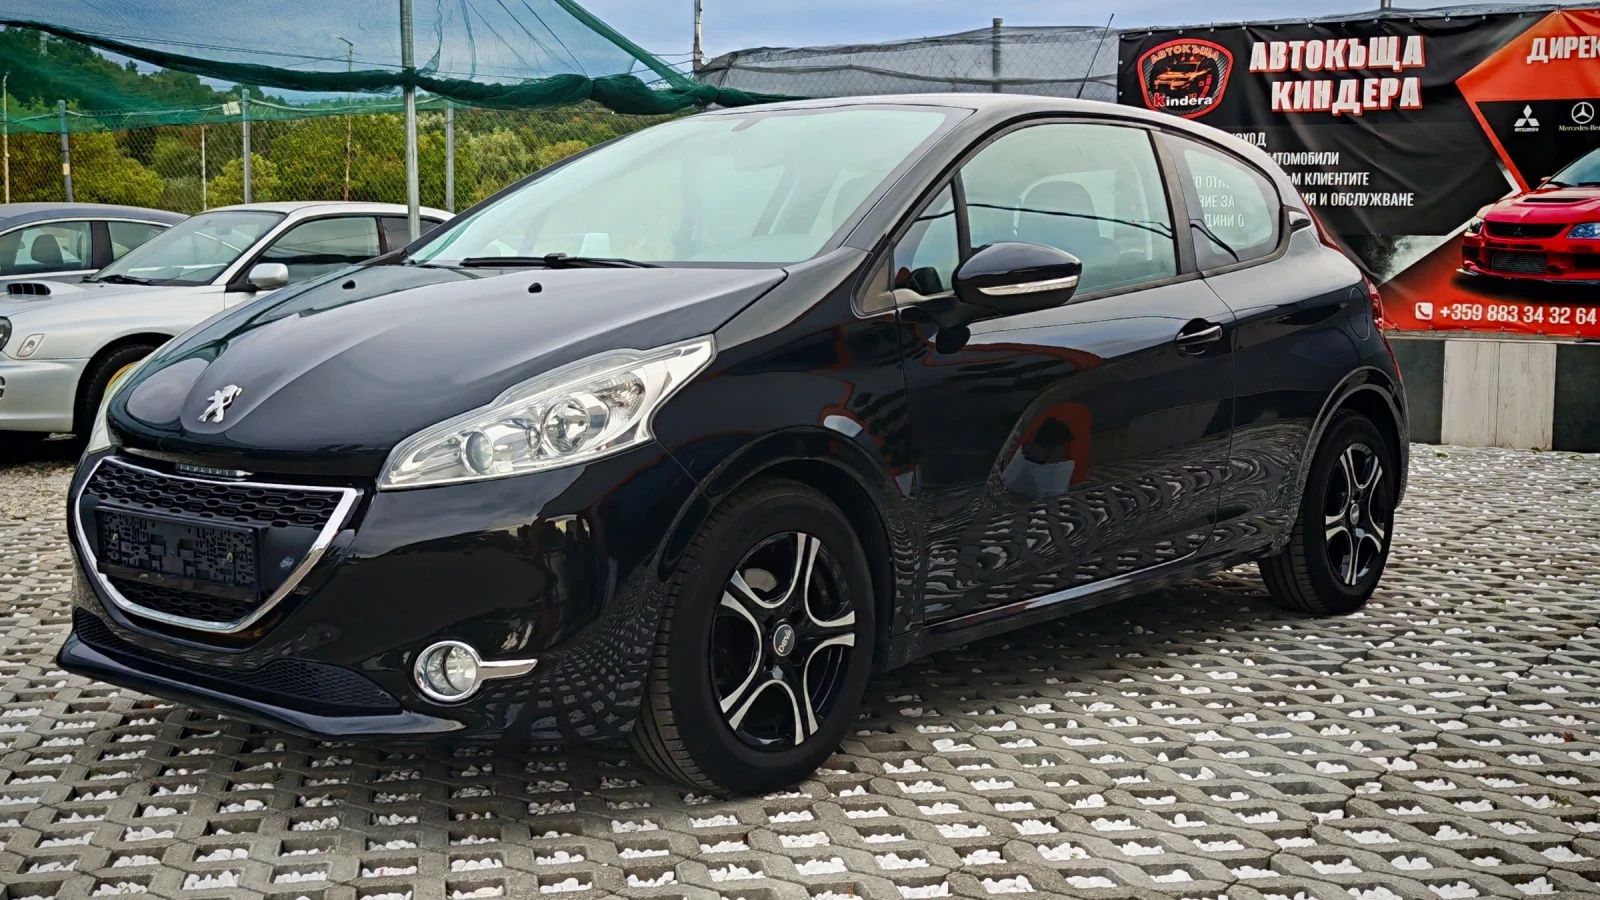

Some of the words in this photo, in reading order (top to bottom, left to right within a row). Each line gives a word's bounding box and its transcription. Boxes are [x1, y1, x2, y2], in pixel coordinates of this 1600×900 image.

[1150, 44, 1220, 64] АВТОКЪЩА
[1249, 35, 1425, 73] АВТОКЪЩА
[1153, 92, 1213, 107] Kindera
[1271, 77, 1423, 116] КИНДЕРА
[1231, 132, 1267, 148] ХОД
[1304, 172, 1370, 186] КЛИЕНТИТЕ
[1220, 195, 1235, 208] ЗА
[1319, 192, 1328, 206] И
[1330, 192, 1415, 207] ОБСЛУЖВАНЕ
[1439, 303, 1483, 321] +359
[1487, 304, 1519, 322] 883
[1523, 305, 1544, 324] 34
[1548, 306, 1571, 324] 32
[1575, 307, 1597, 325] 64
